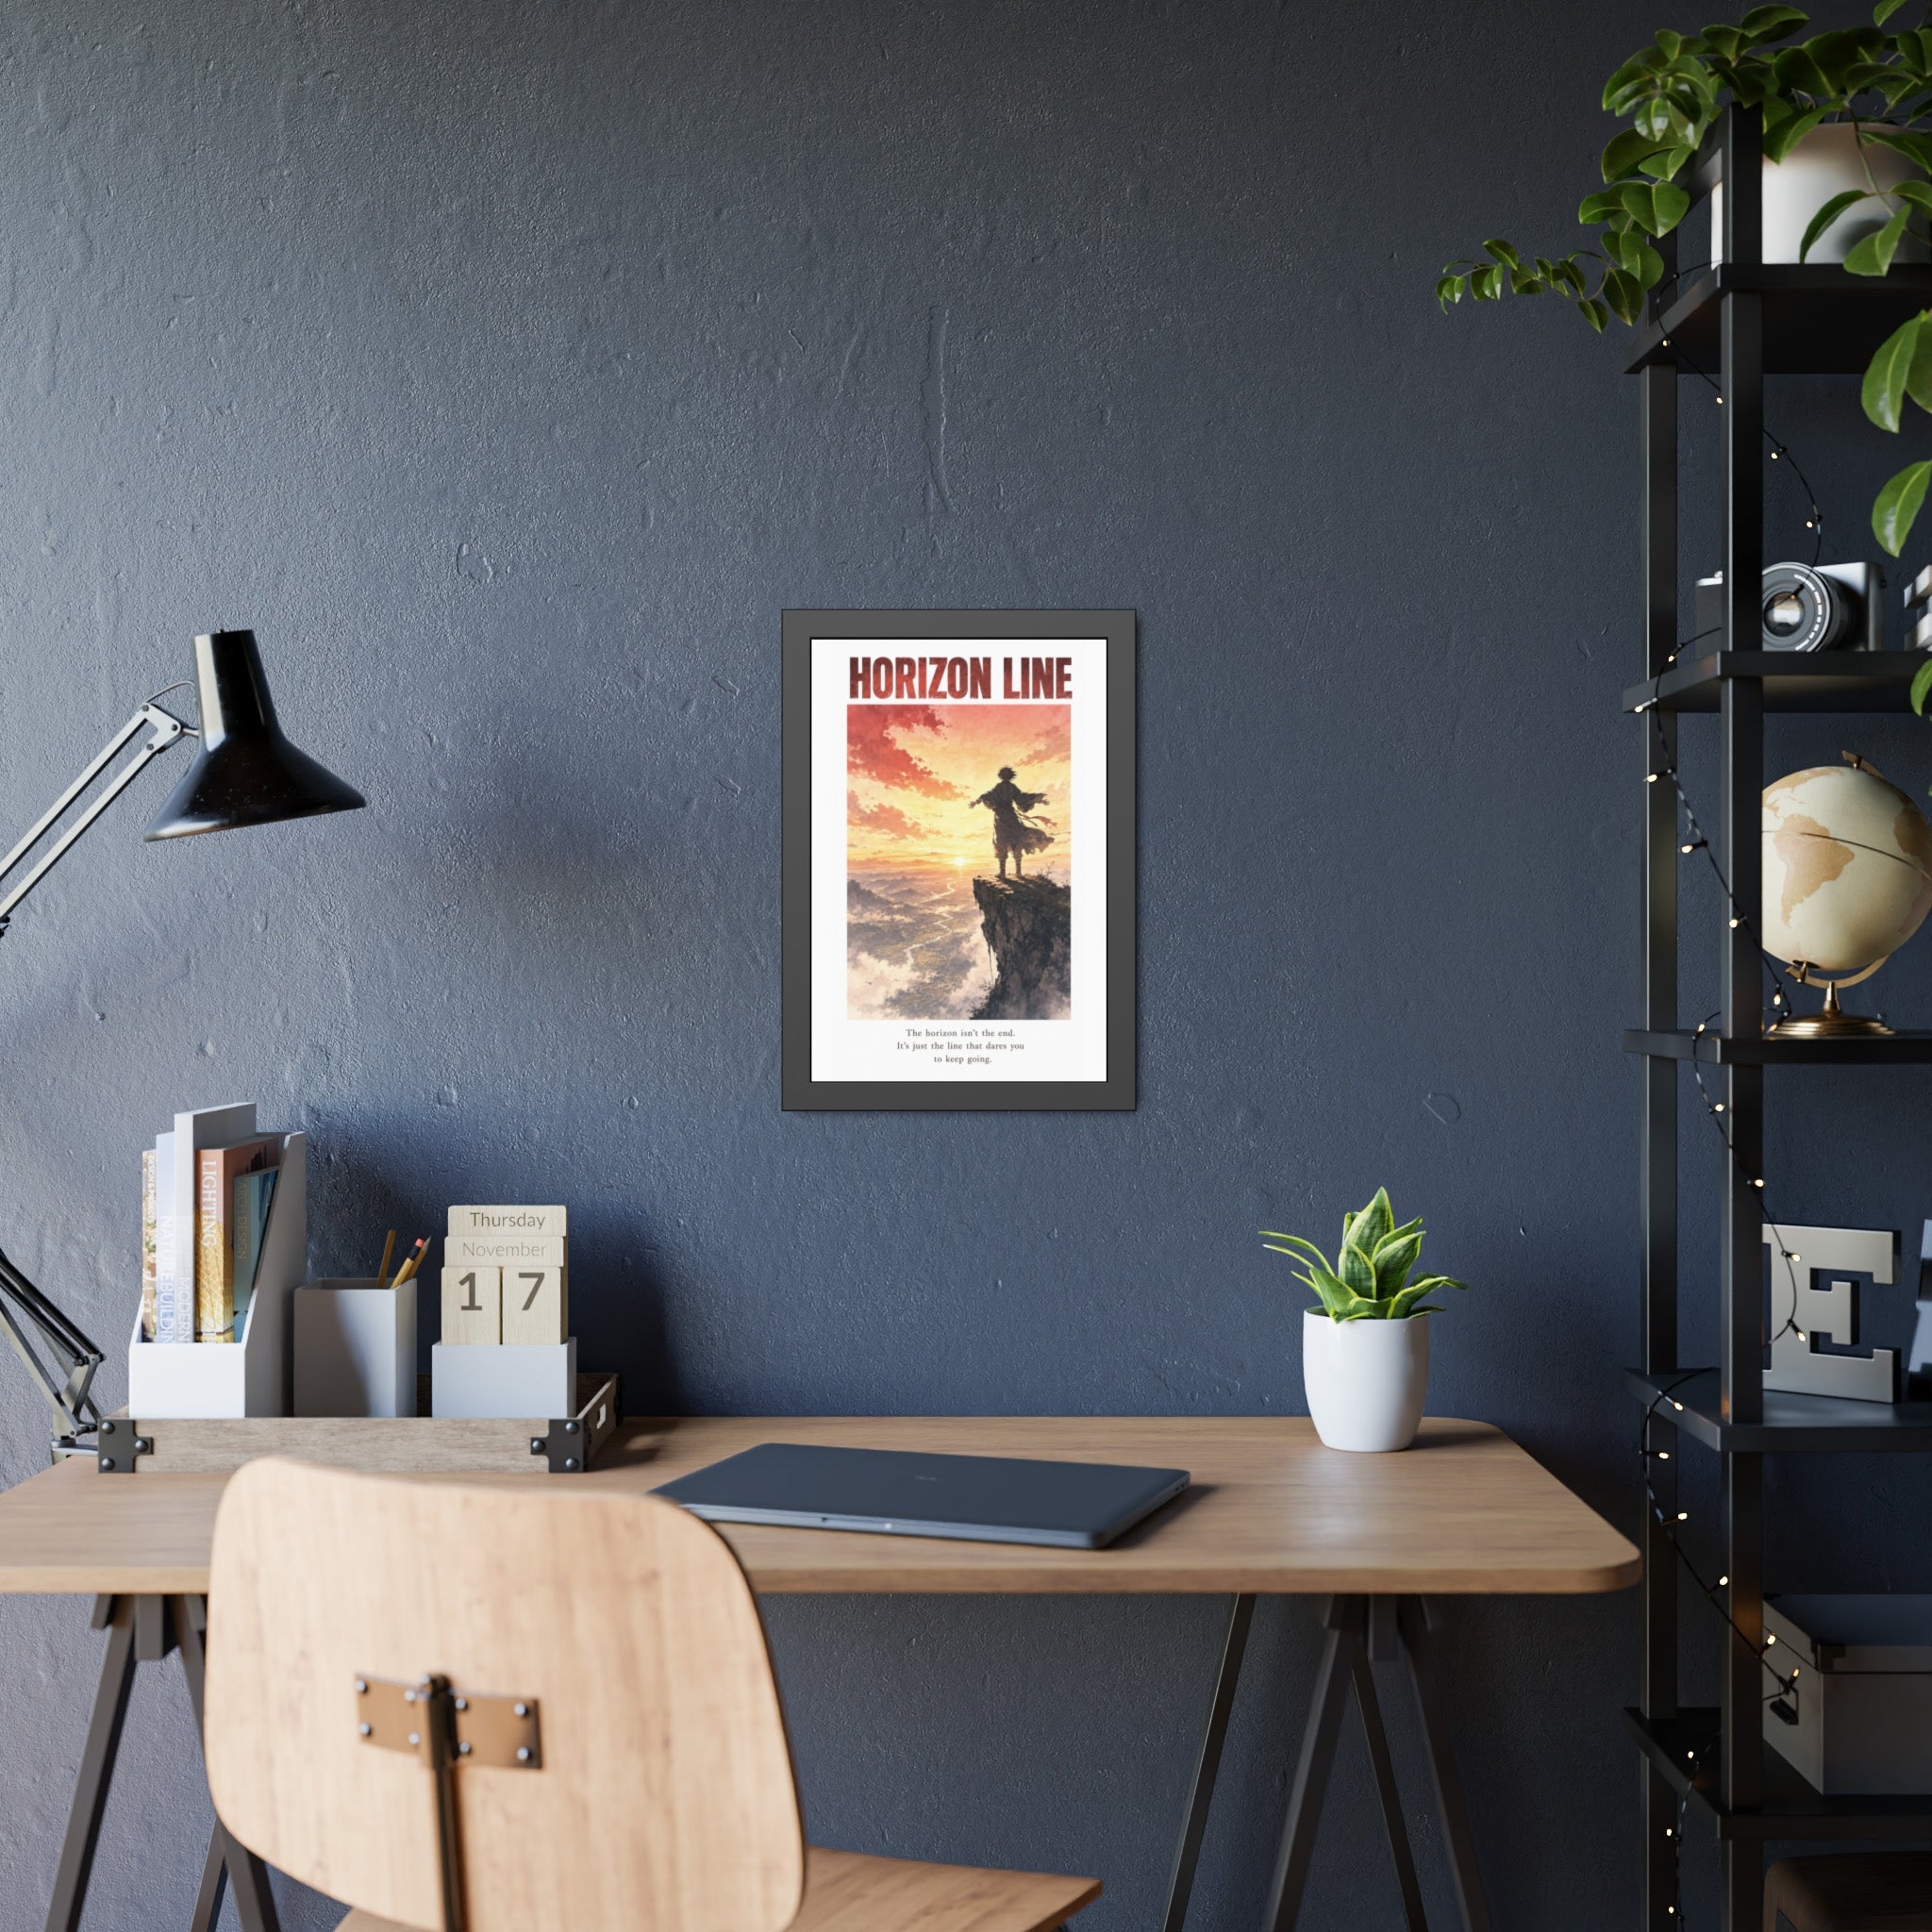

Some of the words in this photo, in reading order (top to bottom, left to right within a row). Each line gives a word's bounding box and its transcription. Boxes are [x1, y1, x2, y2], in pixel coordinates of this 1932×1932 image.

[849, 657, 991, 699] HORIZON
[1003, 657, 1073, 699] LINE
[906, 1028, 923, 1037] The
[925, 1028, 958, 1037] horizon
[960, 1028, 978, 1037] isn't
[981, 1028, 995, 1037] the
[998, 1028, 1016, 1037] end.
[897, 1041, 909, 1050] It's
[911, 1041, 927, 1052] just
[931, 1041, 944, 1050] the
[947, 1041, 962, 1050] line
[966, 1041, 982, 1050] that
[986, 1041, 1008, 1050] dares
[1009, 1043, 1024, 1052] you
[945, 1055, 964, 1064] keep
[967, 1056, 992, 1065] going.
[202, 1160, 217, 1247] LIGHTING
[470, 1212, 546, 1230] Thursday
[238, 1216, 247, 1259] DESIGN
[462, 1242, 547, 1257] November
[177, 1276, 191, 1343] MODERN
